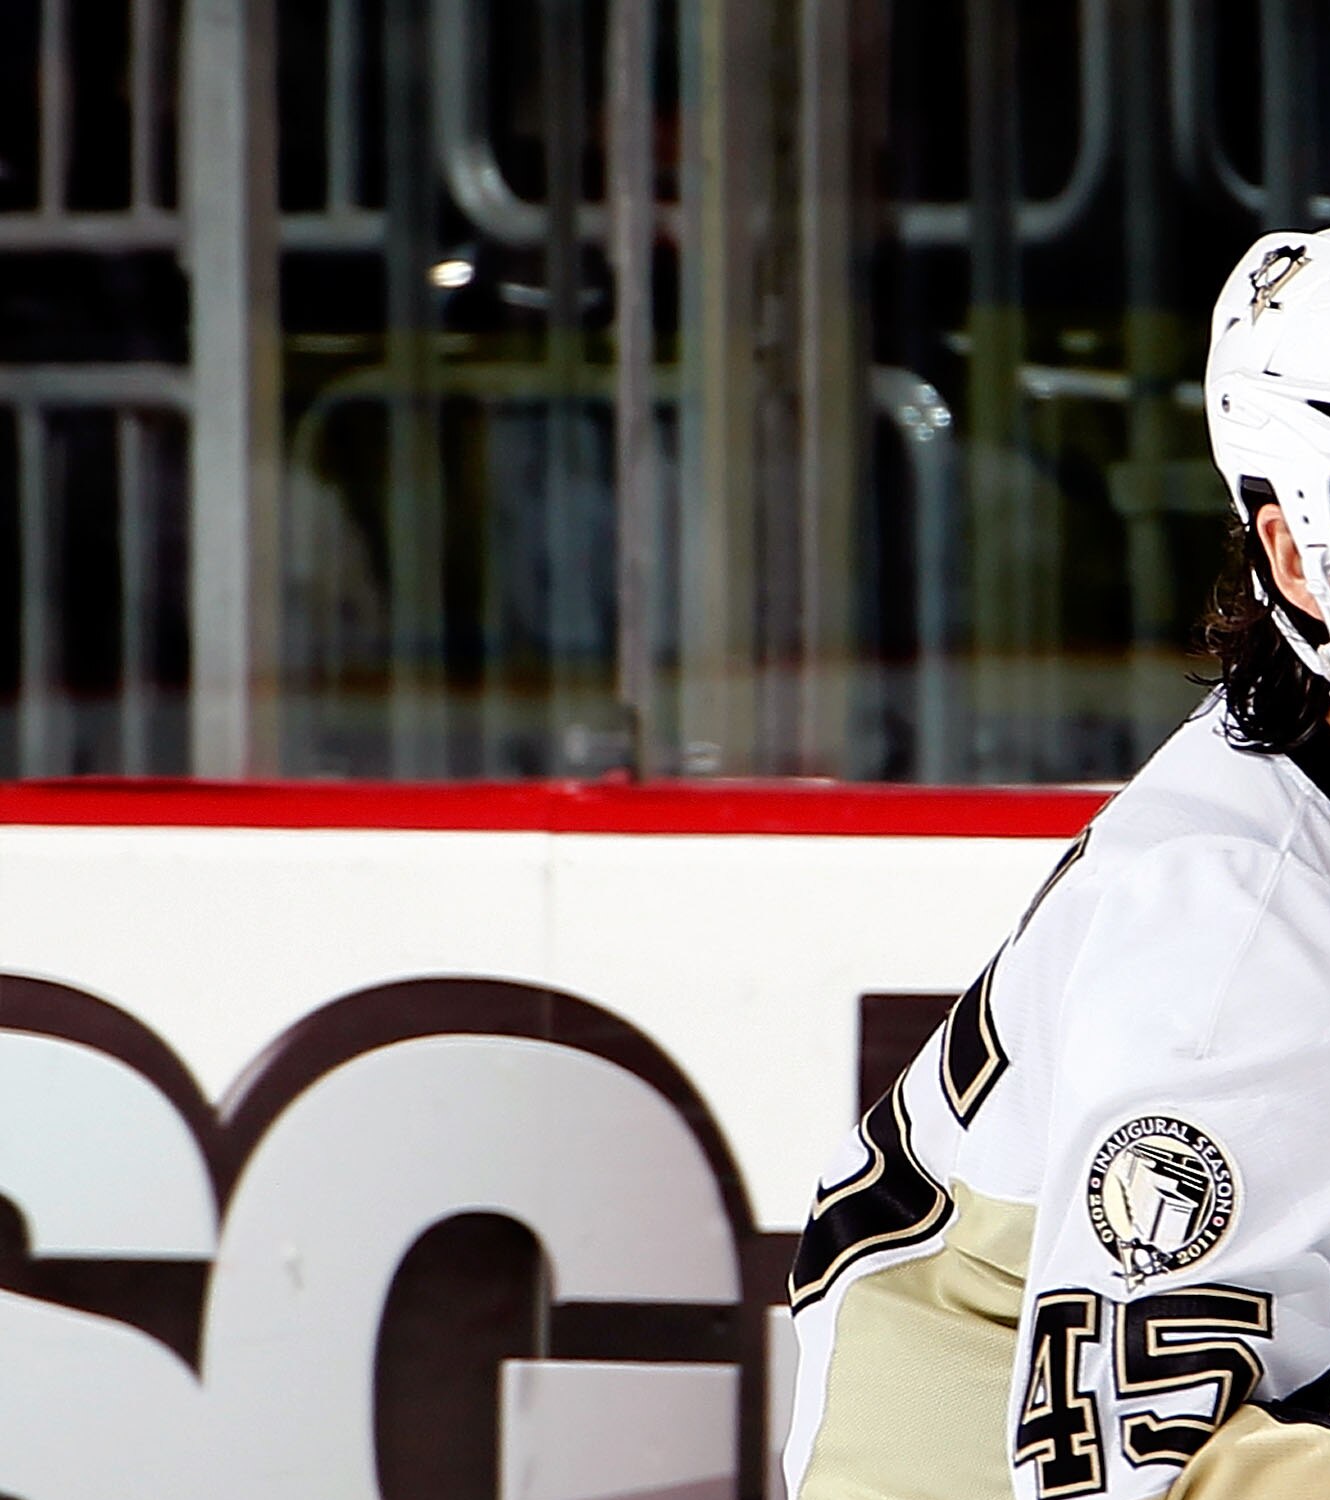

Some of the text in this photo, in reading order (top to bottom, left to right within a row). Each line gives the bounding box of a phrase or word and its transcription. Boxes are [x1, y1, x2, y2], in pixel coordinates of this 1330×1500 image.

[1093, 1117, 1233, 1220] INAUGURAL SEASON
[1090, 1193, 1218, 1265] 2010 2011
